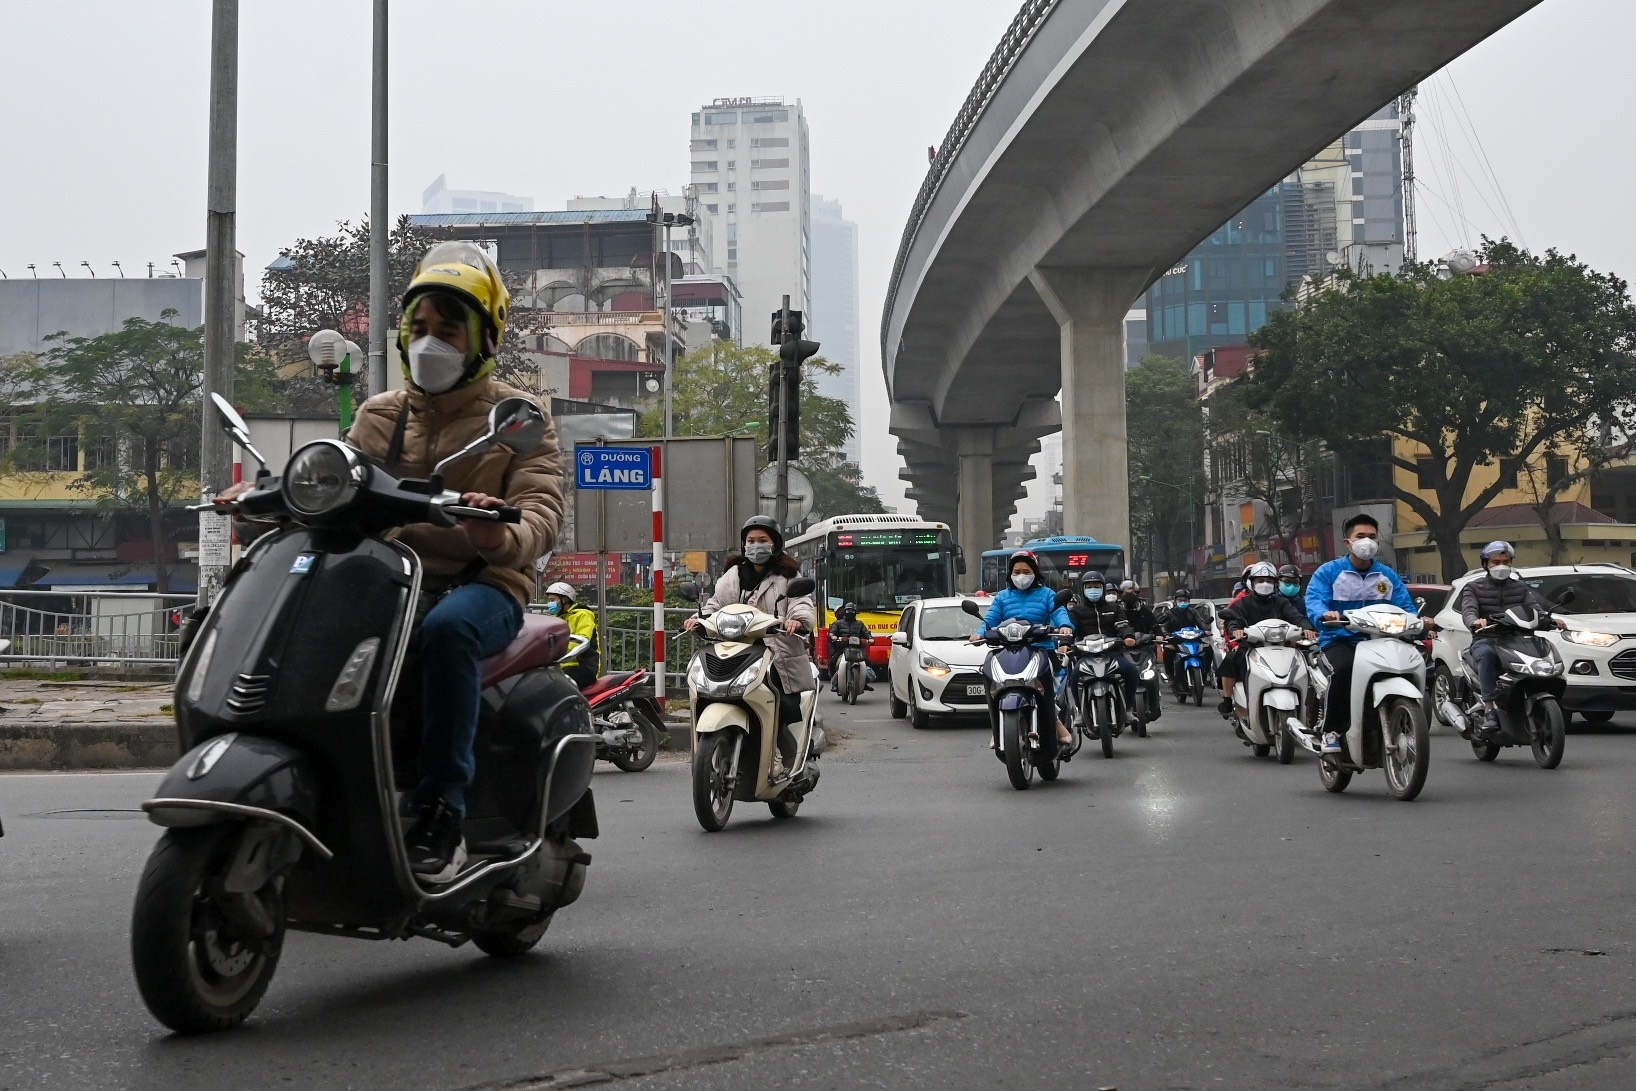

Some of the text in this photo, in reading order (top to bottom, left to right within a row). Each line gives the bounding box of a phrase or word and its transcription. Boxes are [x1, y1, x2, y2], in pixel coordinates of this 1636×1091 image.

[601, 452, 641, 462] ĐƯỜNG
[584, 465, 644, 483] LÁNG
[1068, 555, 1089, 566] 27
[967, 686, 985, 695] 30G-
